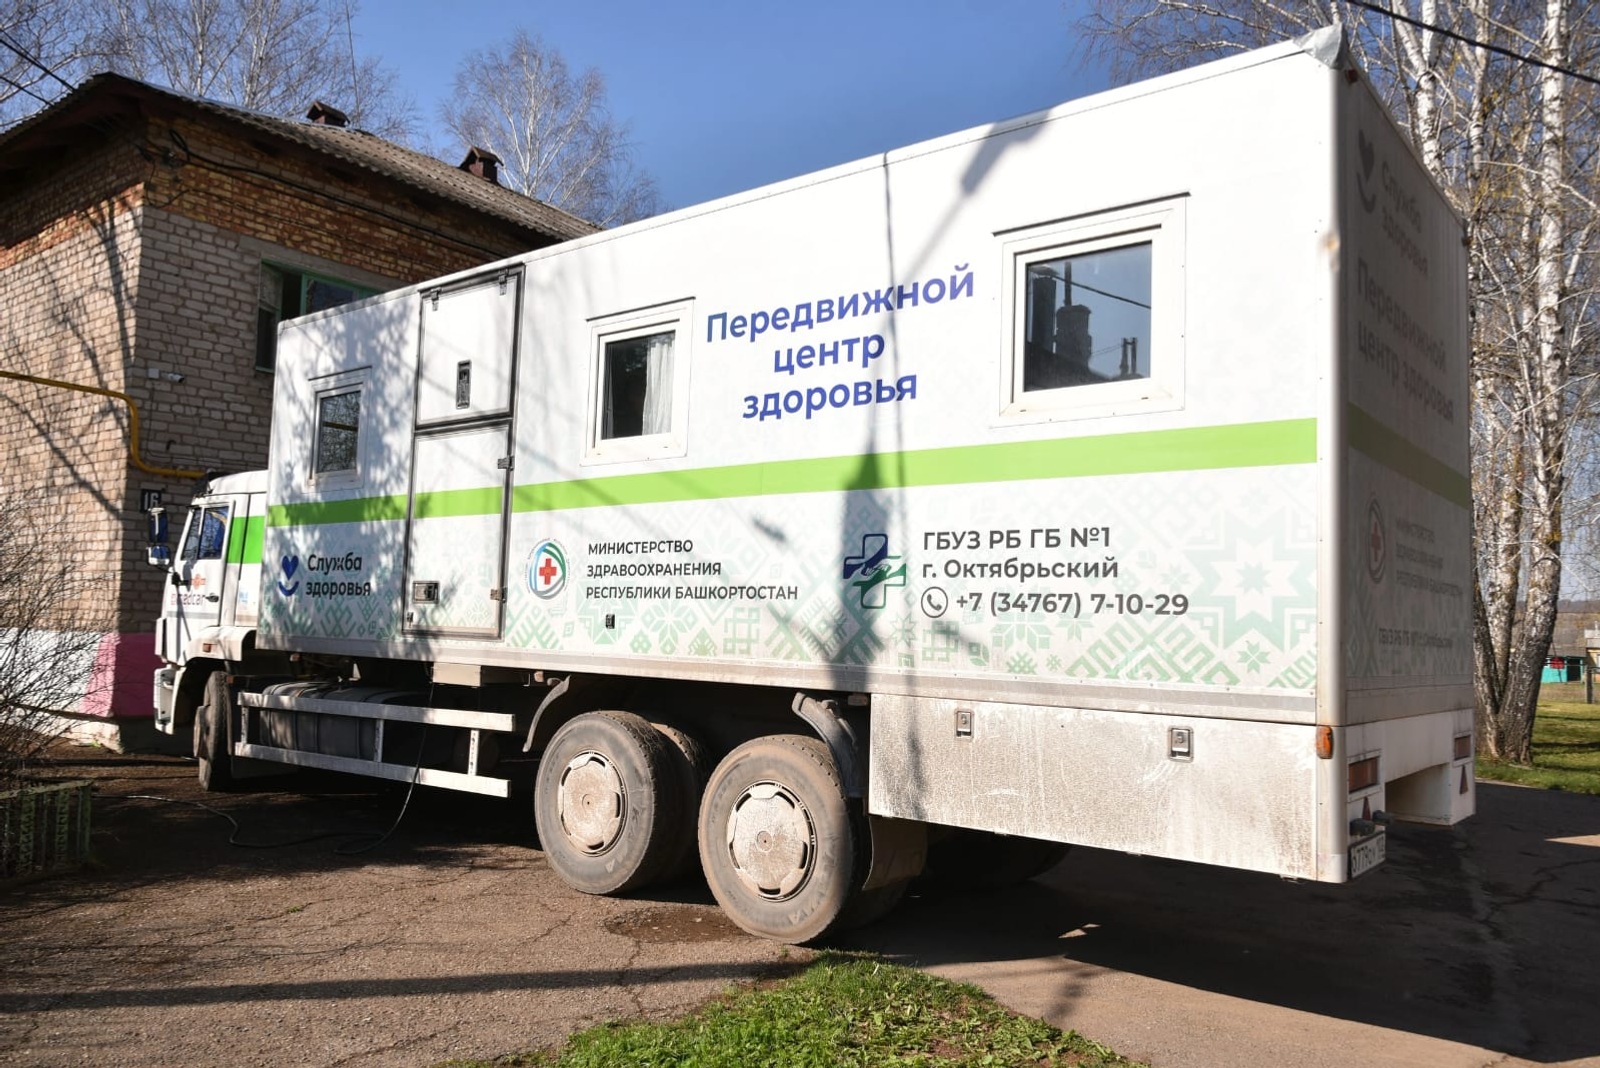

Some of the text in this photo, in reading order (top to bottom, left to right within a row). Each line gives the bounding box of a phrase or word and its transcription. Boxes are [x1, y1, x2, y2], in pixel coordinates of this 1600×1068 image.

[707, 263, 974, 343] Передвижной
[773, 333, 885, 375] центр
[742, 374, 917, 421] здоровья
[588, 539, 694, 556] МИНИСТЕРСТВО
[923, 527, 1111, 550] ГБУЗ РБ ГБ №1
[307, 552, 363, 575] Служба
[586, 562, 722, 579] ЗДРАВООХРАНЕНИЯ
[922, 556, 1119, 583] г. Октябрьский
[305, 580, 371, 597] здоровья
[585, 585, 799, 600] РЕСПУБЛИКИ БАШКОРТОСТАН
[956, 592, 1190, 619] +7 (34767) 7-10-29
